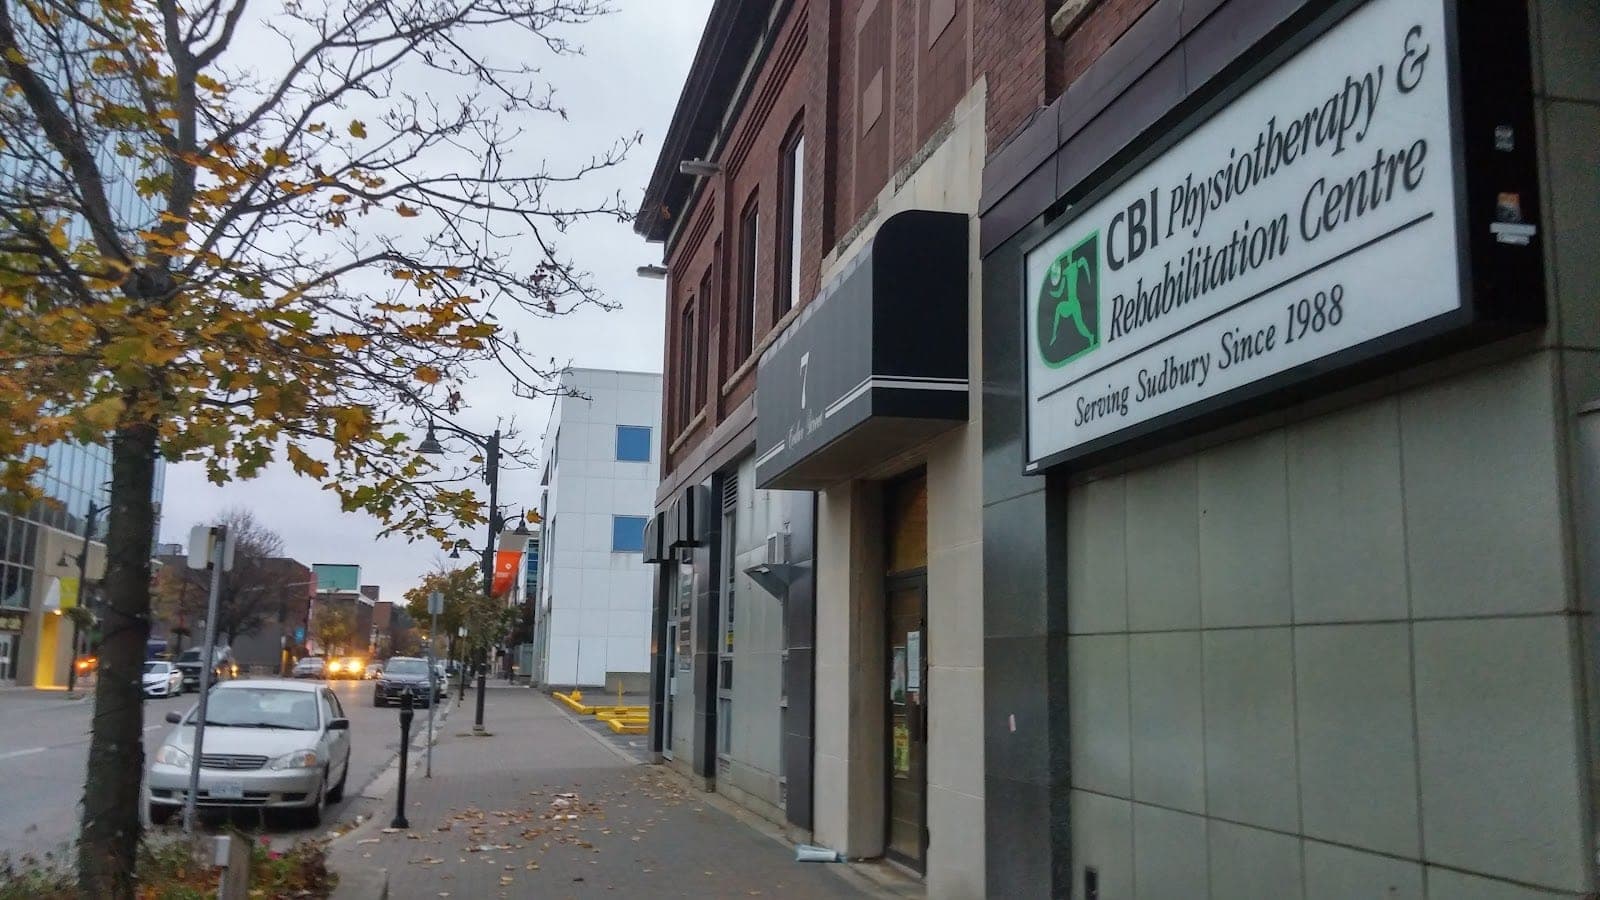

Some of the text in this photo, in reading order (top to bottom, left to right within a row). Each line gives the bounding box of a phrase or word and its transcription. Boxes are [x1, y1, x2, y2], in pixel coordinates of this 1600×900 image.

[1106, 25, 1430, 271] CBI Physiotherapy &
[1108, 139, 1428, 343] Rehabilitation Centre
[800, 351, 810, 409] 7
[1074, 283, 1344, 427] Serving Sudbury Since 1988
